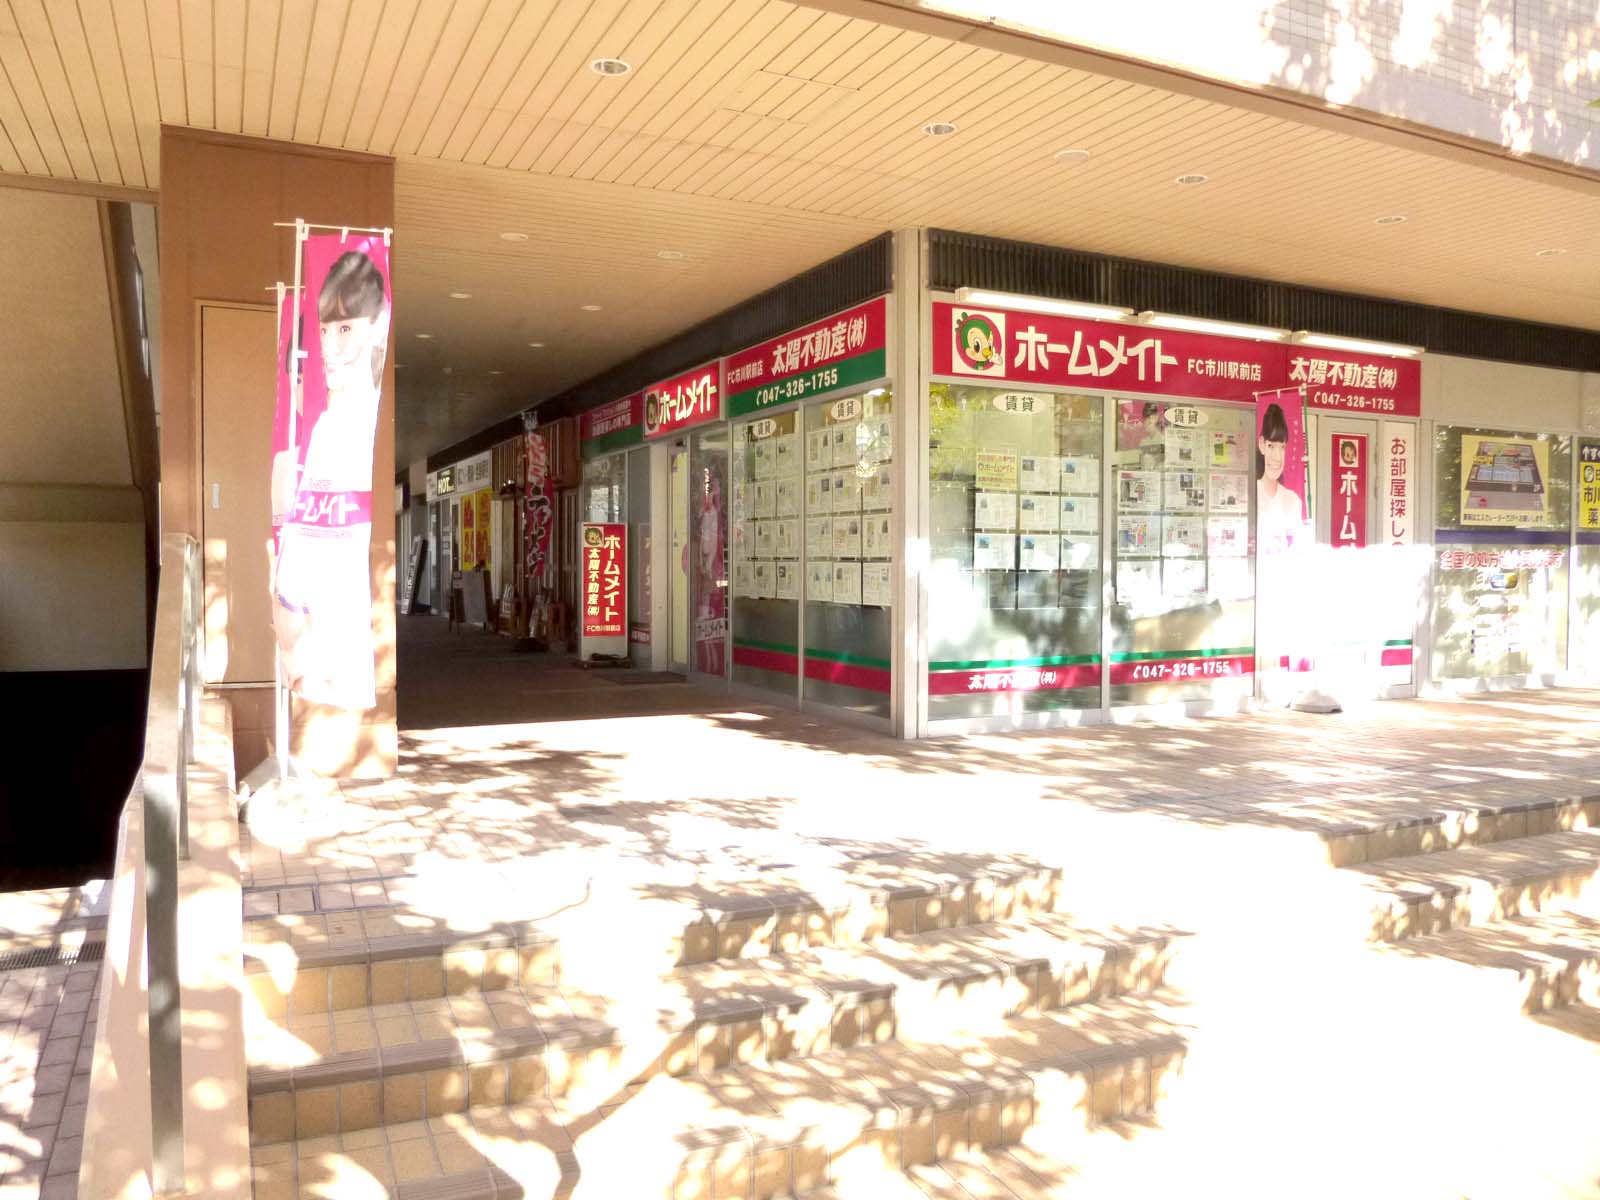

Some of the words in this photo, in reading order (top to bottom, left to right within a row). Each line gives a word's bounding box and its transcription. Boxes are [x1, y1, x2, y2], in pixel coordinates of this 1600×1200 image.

[771, 314, 867, 376] 太陽不動産(株)
[1014, 326, 1178, 382] ホームメイト
[762, 368, 838, 404] 047-326-1755
[1187, 358, 1262, 382] FC市川駅前店
[1289, 357, 1398, 390] 太陽不動産(株)
[659, 374, 717, 424] ホームメイト
[1005, 395, 1034, 412] 賃貸
[1174, 408, 1199, 424] 賃貸
[1321, 393, 1395, 411] 047-326-1755
[1340, 471, 1358, 546] ホーム
[1390, 437, 1407, 545] お部屋探し
[604, 535, 620, 622] ホームメイト
[1142, 661, 1230, 679] 047-326-1755
